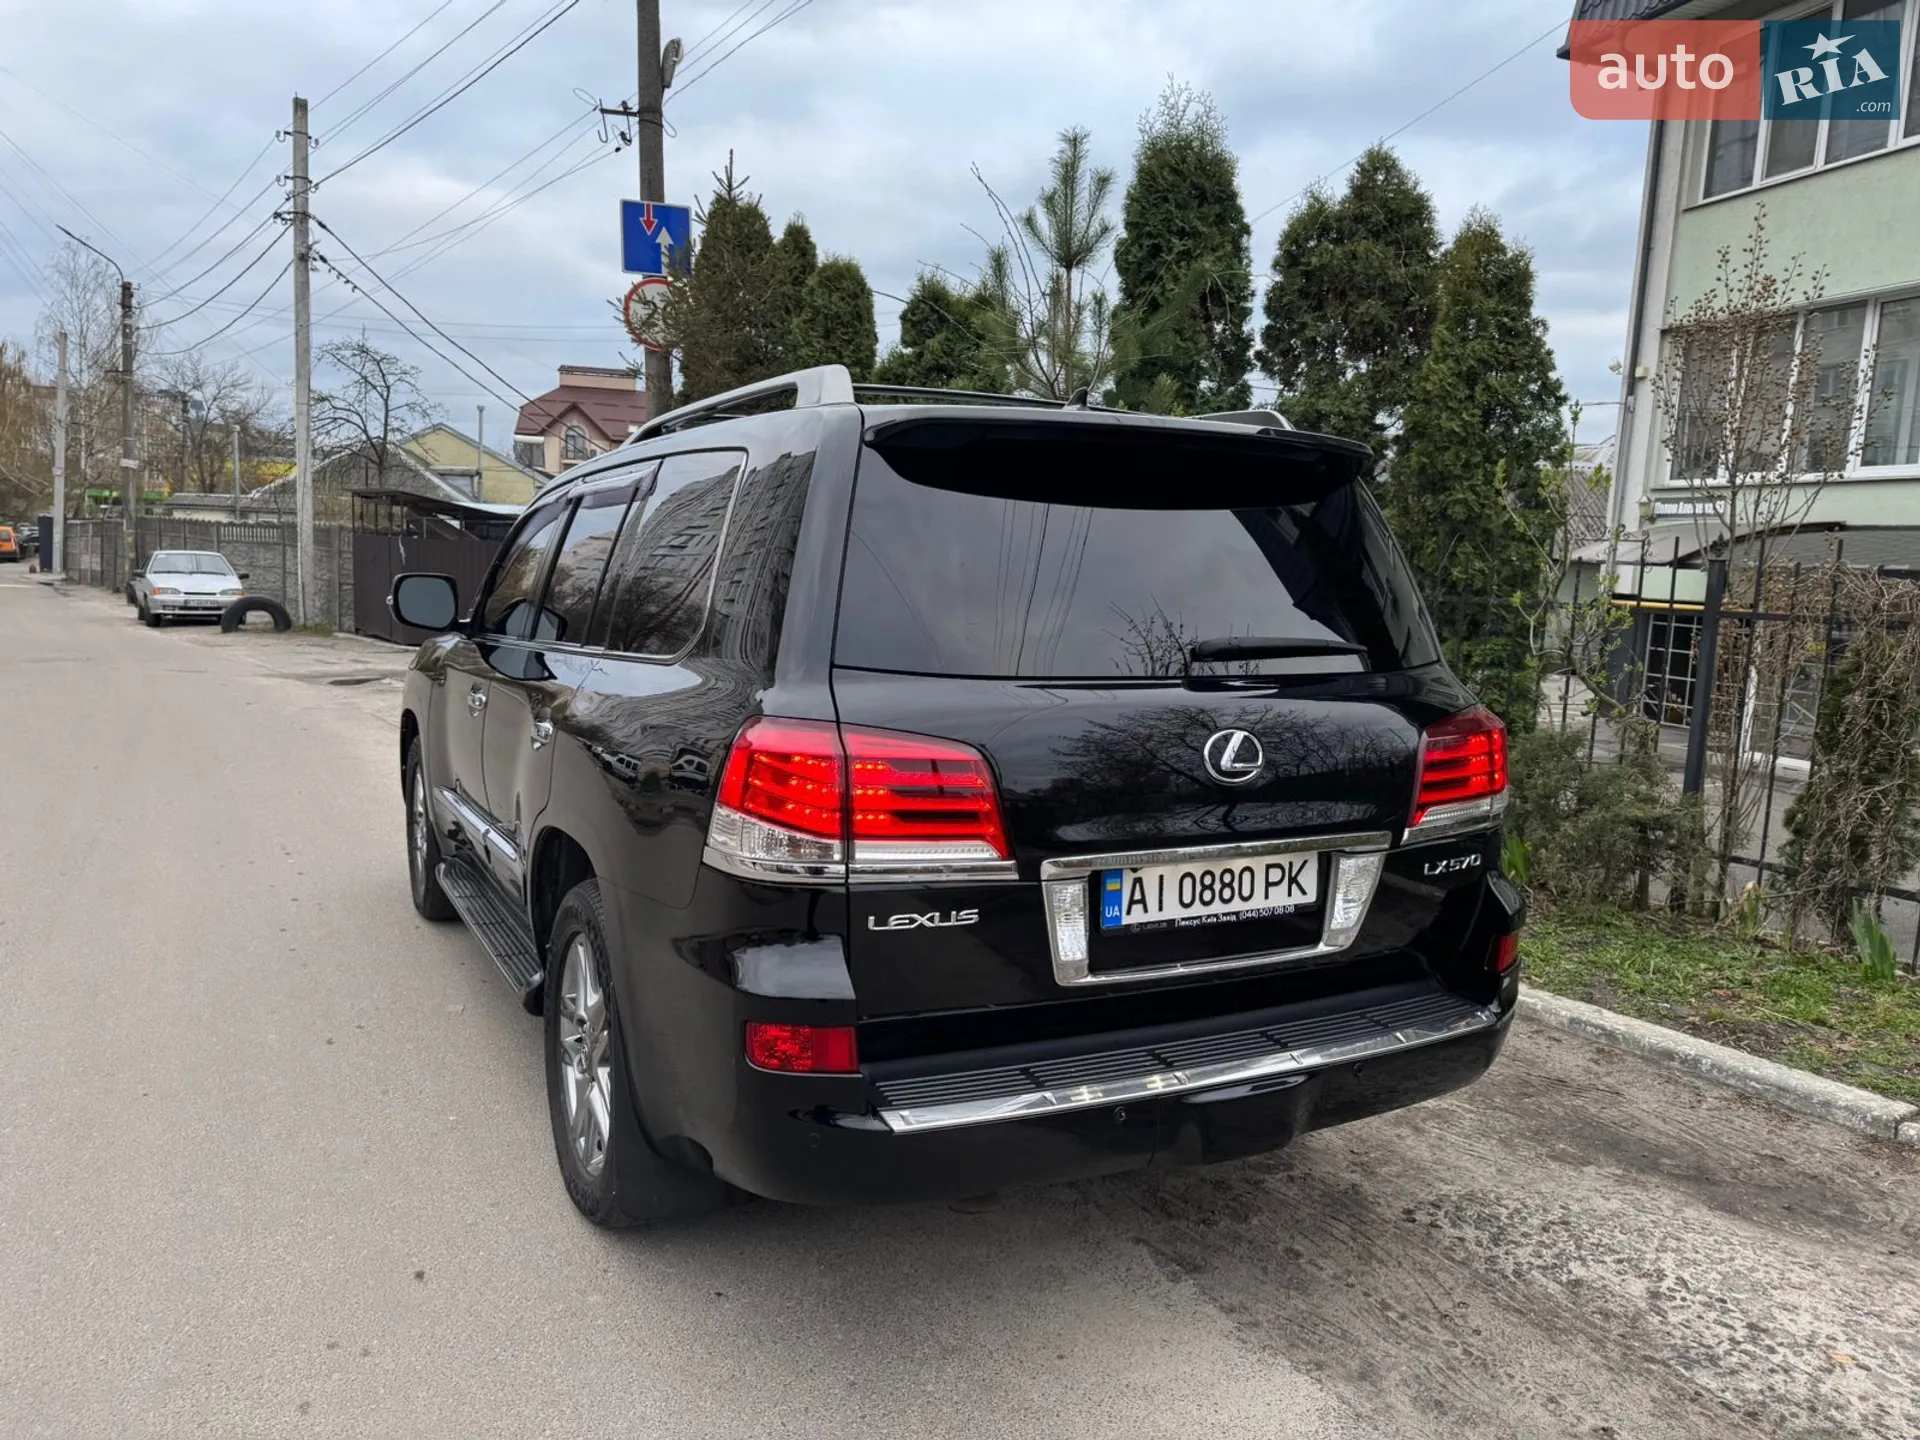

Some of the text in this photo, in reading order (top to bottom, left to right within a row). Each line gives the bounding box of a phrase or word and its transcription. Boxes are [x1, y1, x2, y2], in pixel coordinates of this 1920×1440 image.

[1126, 858, 1309, 916] AI 0880 PK
[867, 908, 980, 931] LEXUS
[1105, 905, 1121, 918] UA
[1239, 909, 1259, 920] (044)
[1259, 906, 1273, 917] 507
[1274, 905, 1284, 915] 08
[1285, 904, 1295, 914] 08
